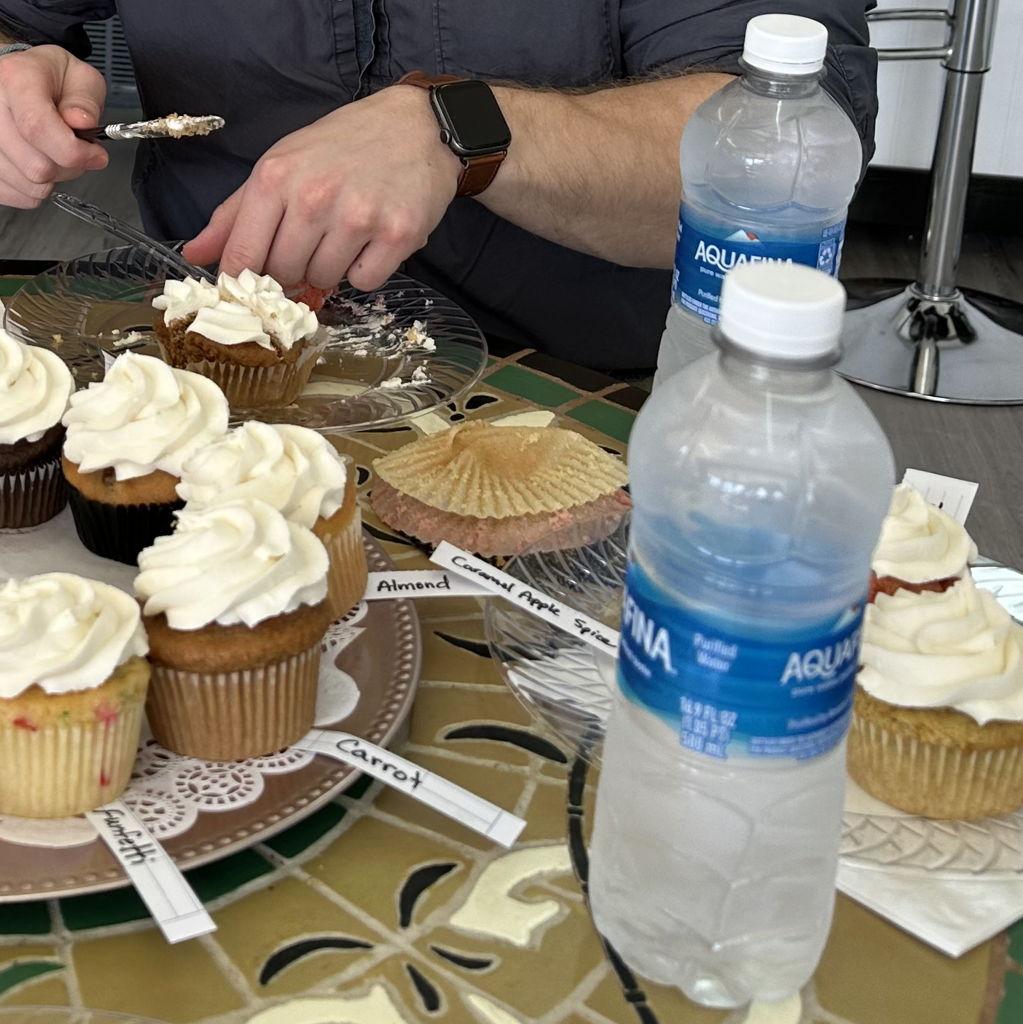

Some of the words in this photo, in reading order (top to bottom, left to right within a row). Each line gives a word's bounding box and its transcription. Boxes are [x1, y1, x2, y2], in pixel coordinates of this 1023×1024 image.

[695, 240, 792, 272] AQUA
[377, 574, 451, 592] Almond
[451, 555, 515, 592] Caramel
[518, 590, 561, 617] Apple
[574, 617, 618, 648] Spice
[336, 739, 423, 791] Carrot
